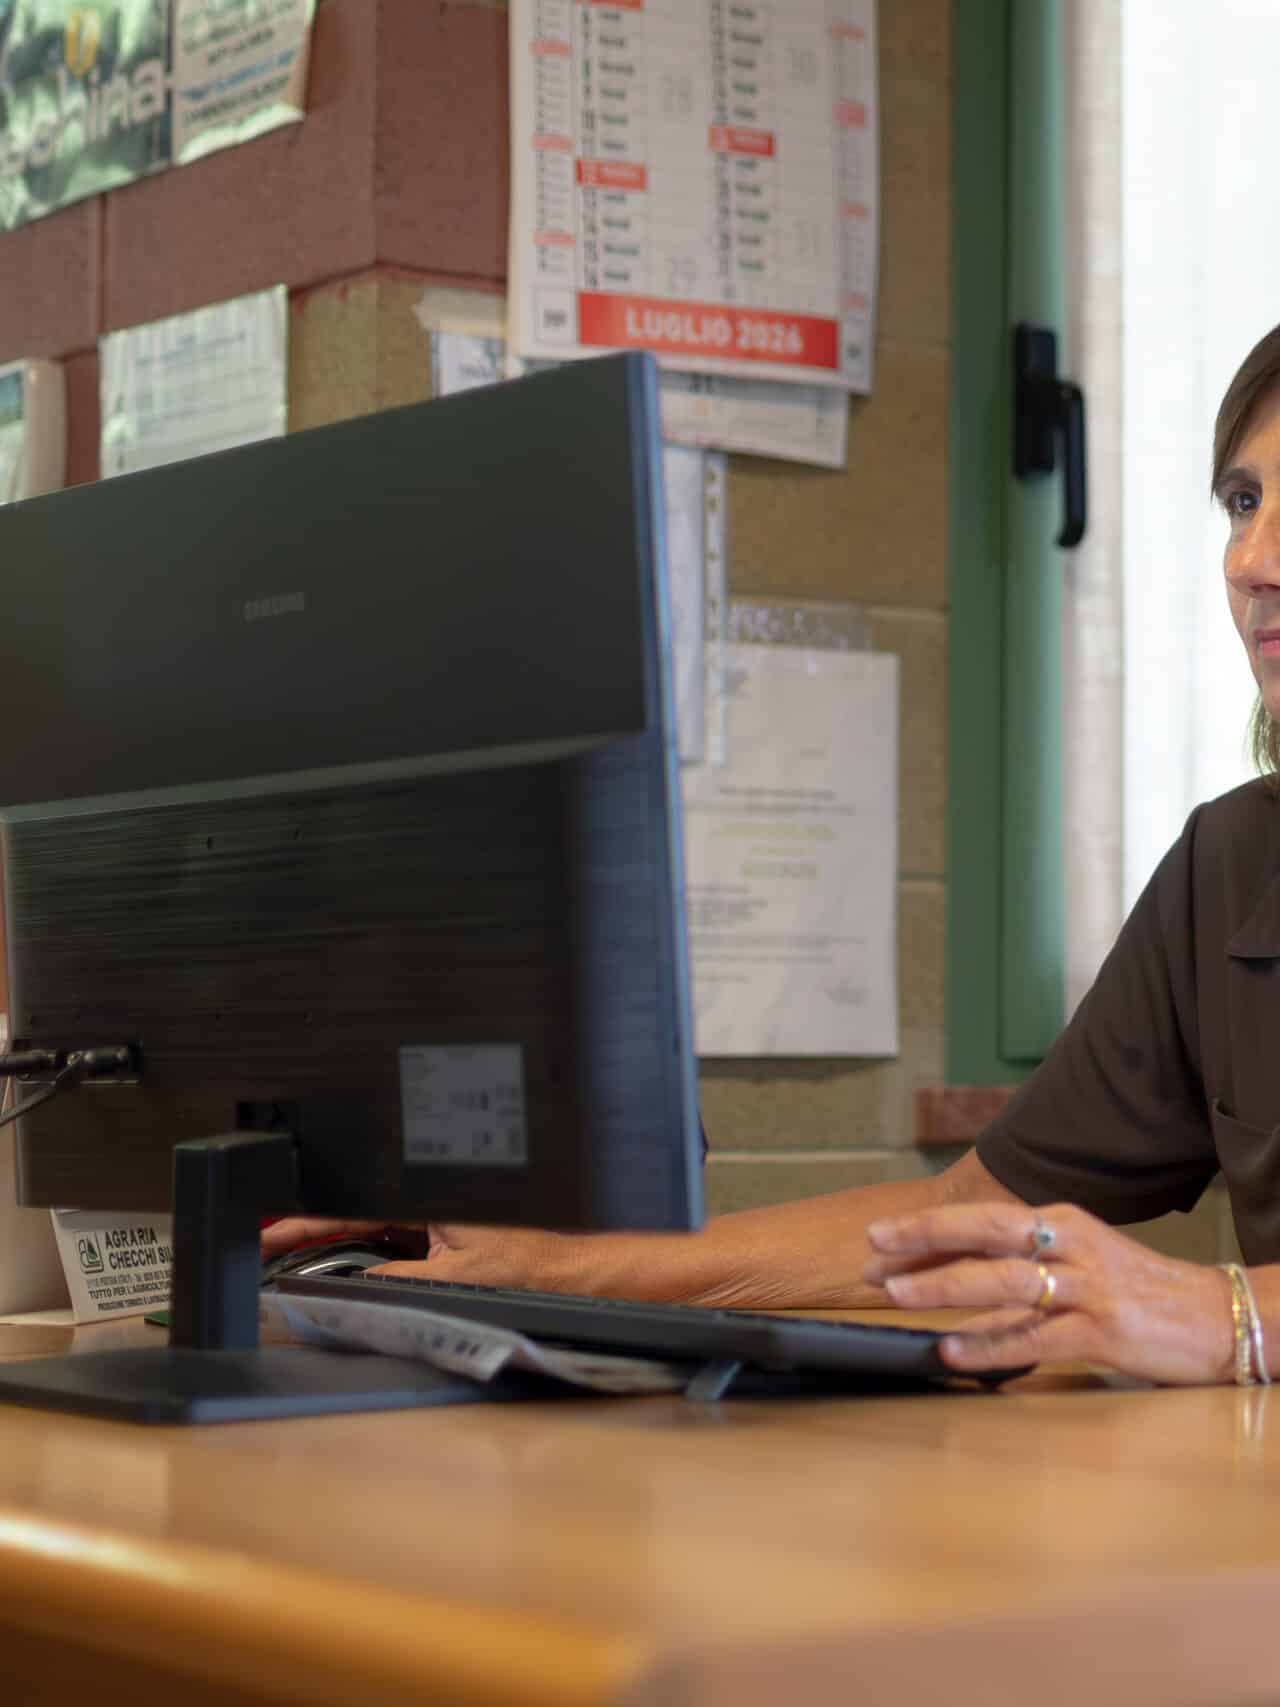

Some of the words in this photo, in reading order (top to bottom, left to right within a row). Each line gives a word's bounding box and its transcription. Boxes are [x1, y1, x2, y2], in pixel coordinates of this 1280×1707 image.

[626, 306, 732, 346] LUGLIO
[736, 319, 803, 353] 2026
[105, 1227, 158, 1249] AGRARIA
[108, 1247, 158, 1270] CHECCHI
[88, 1287, 112, 1300] TUTTO
[112, 1286, 128, 1297] PER
